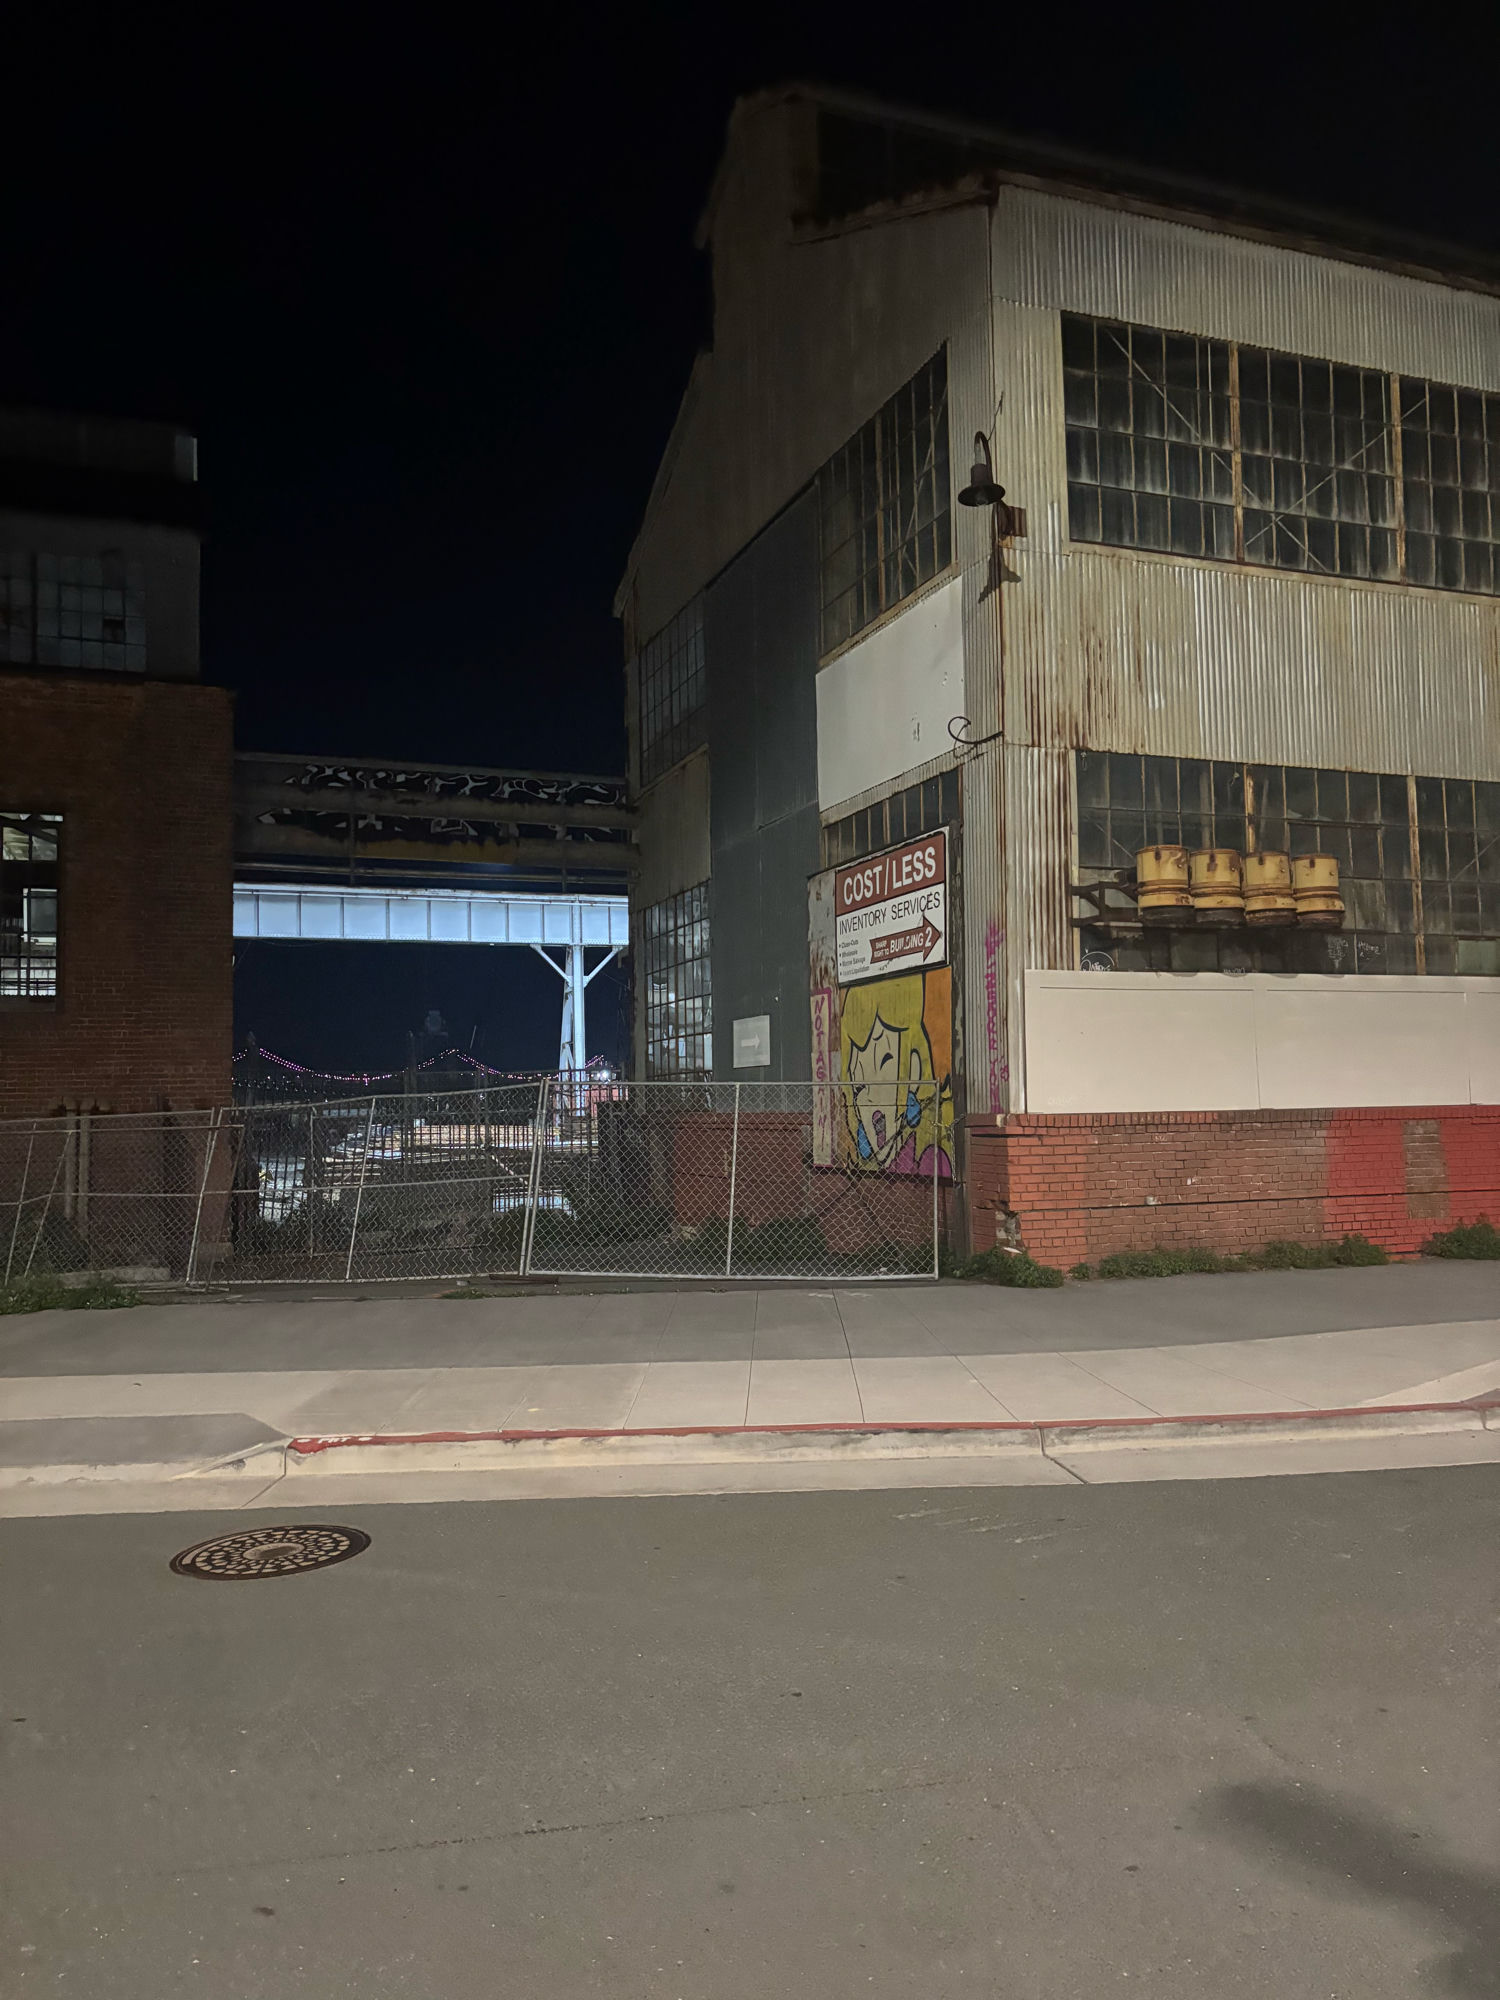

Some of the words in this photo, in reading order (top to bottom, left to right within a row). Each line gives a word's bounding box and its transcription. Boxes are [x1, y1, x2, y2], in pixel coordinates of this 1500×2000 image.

[840, 907, 887, 935] INVENTORY
[891, 891, 941, 920] SERVICES
[925, 927, 933, 948] 2
